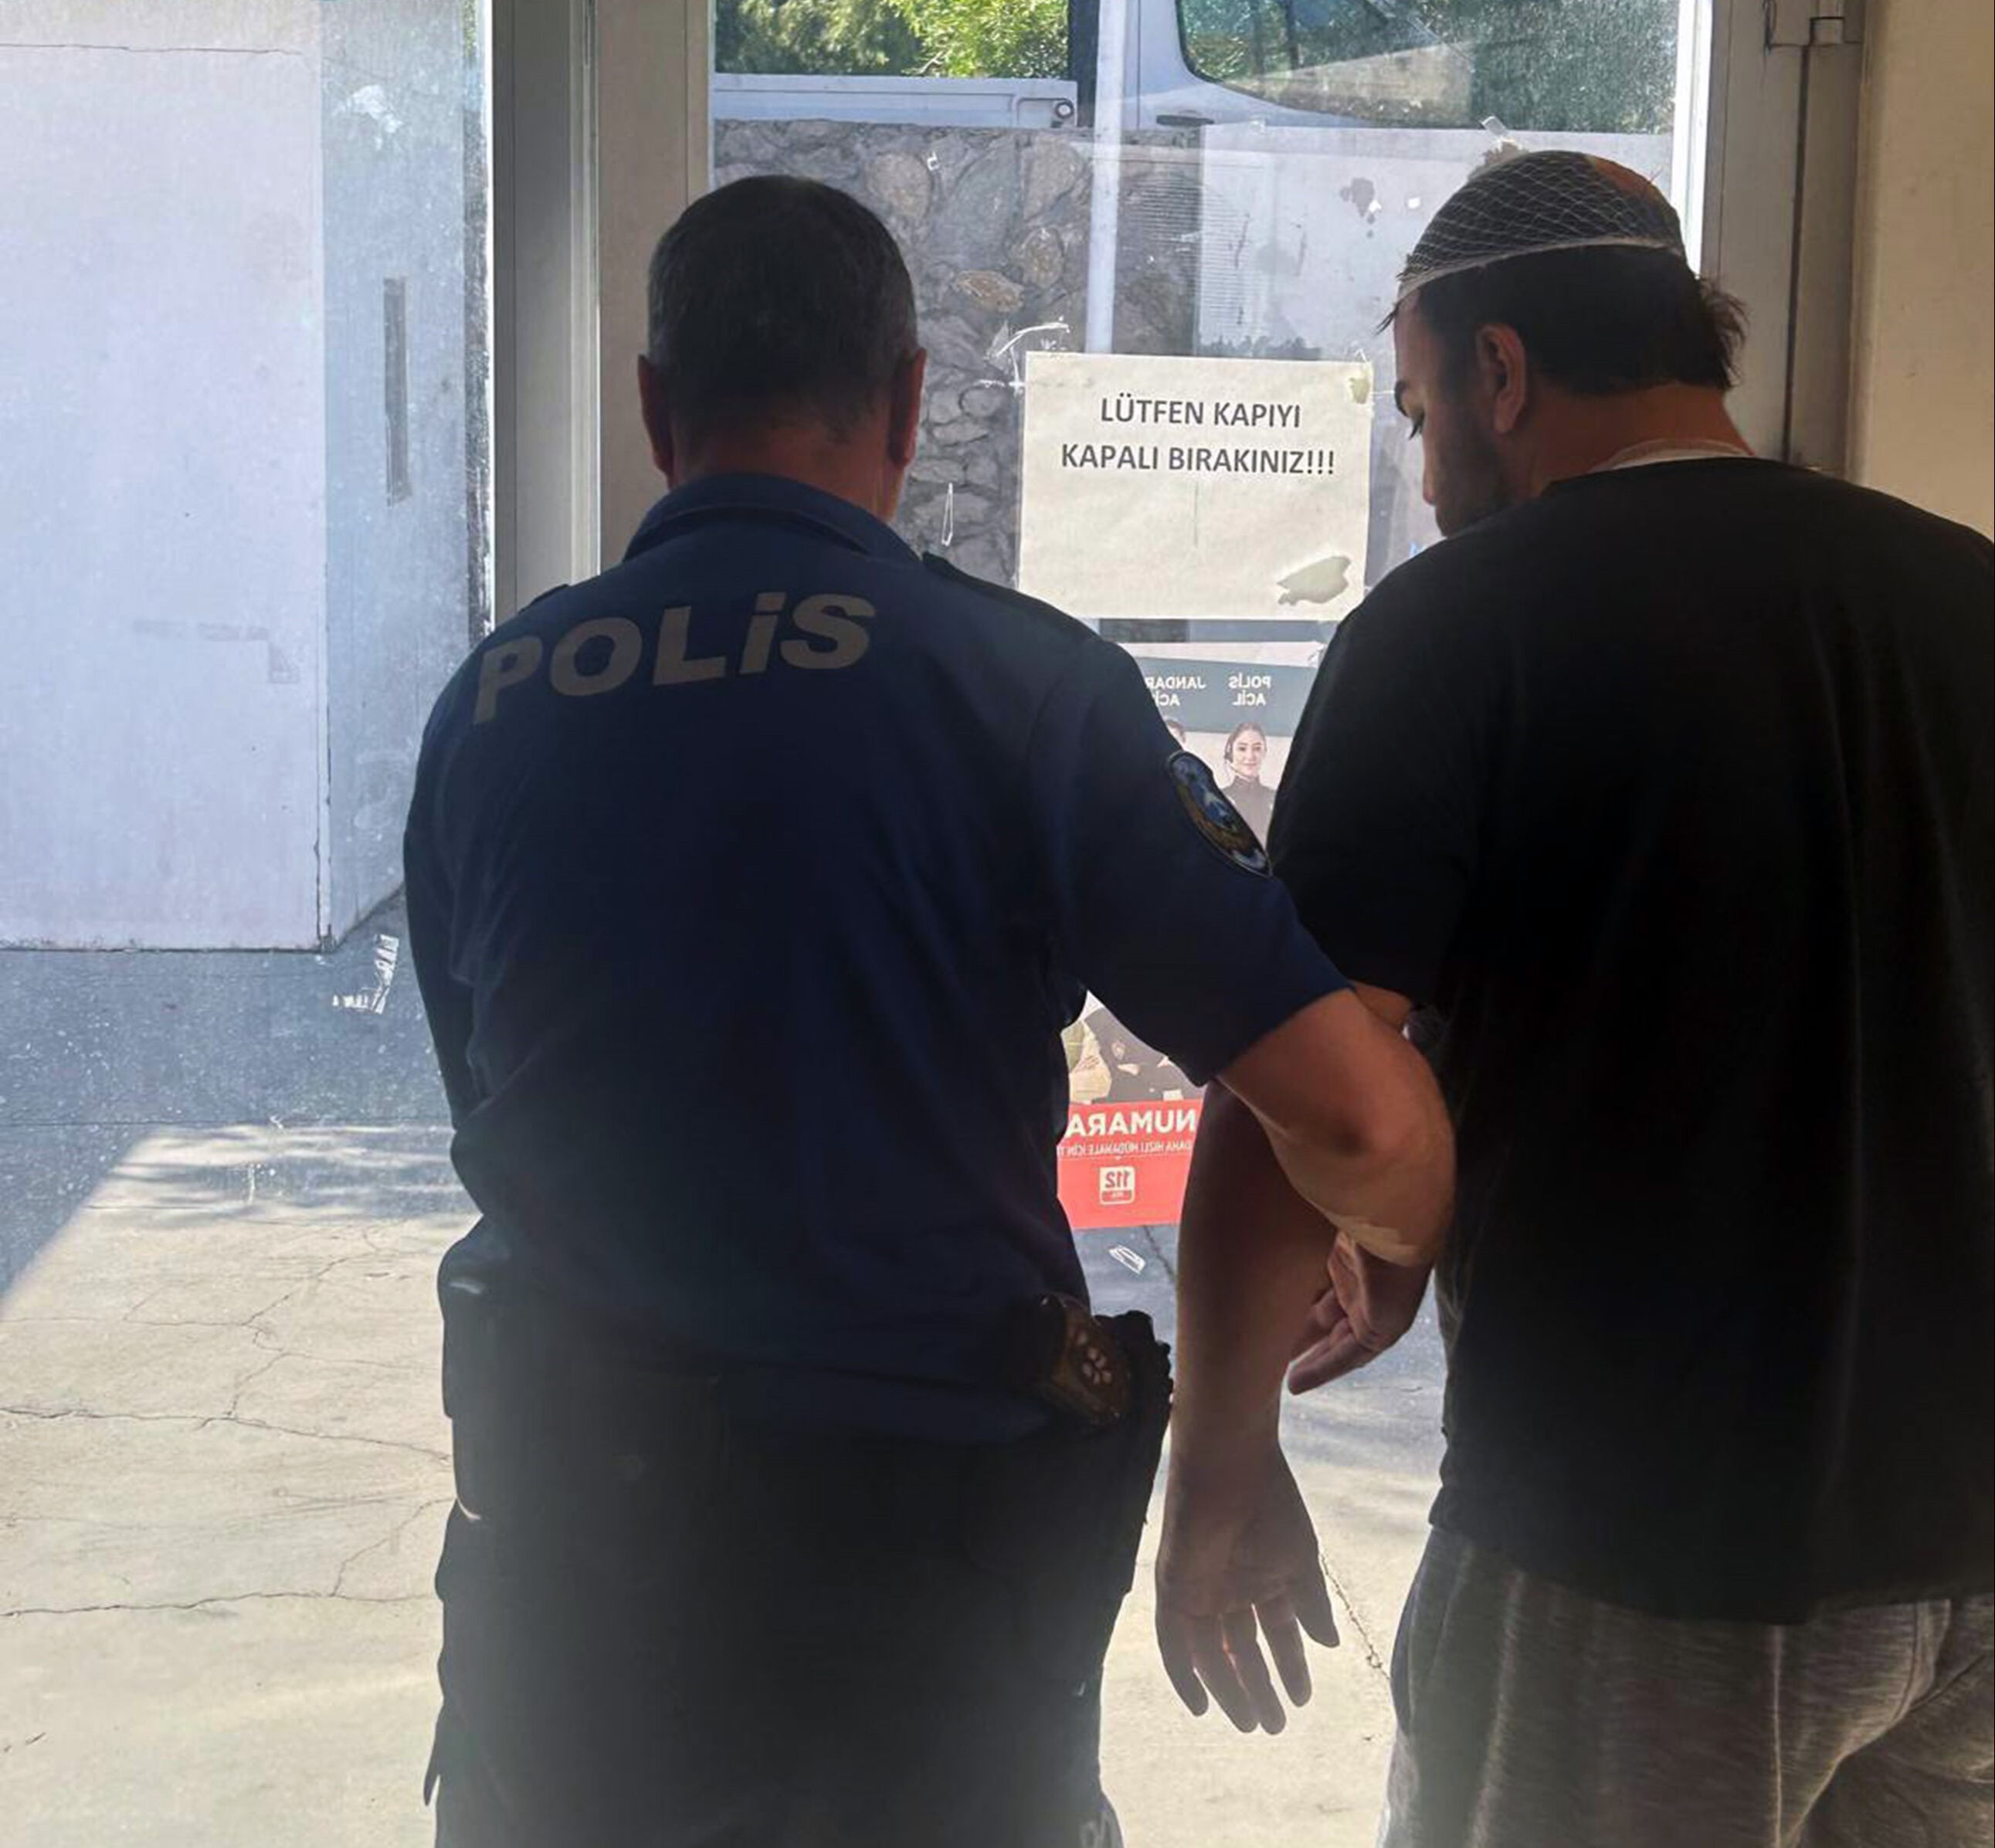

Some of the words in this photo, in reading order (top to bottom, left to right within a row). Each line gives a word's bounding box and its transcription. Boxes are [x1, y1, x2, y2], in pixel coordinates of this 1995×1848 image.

[1101, 392, 1203, 425] LÜTFEN
[1213, 402, 1301, 428] KAPIYI
[1061, 443, 1159, 470] KAPALI
[1169, 447, 1335, 475] BIRAKINIZ!!!
